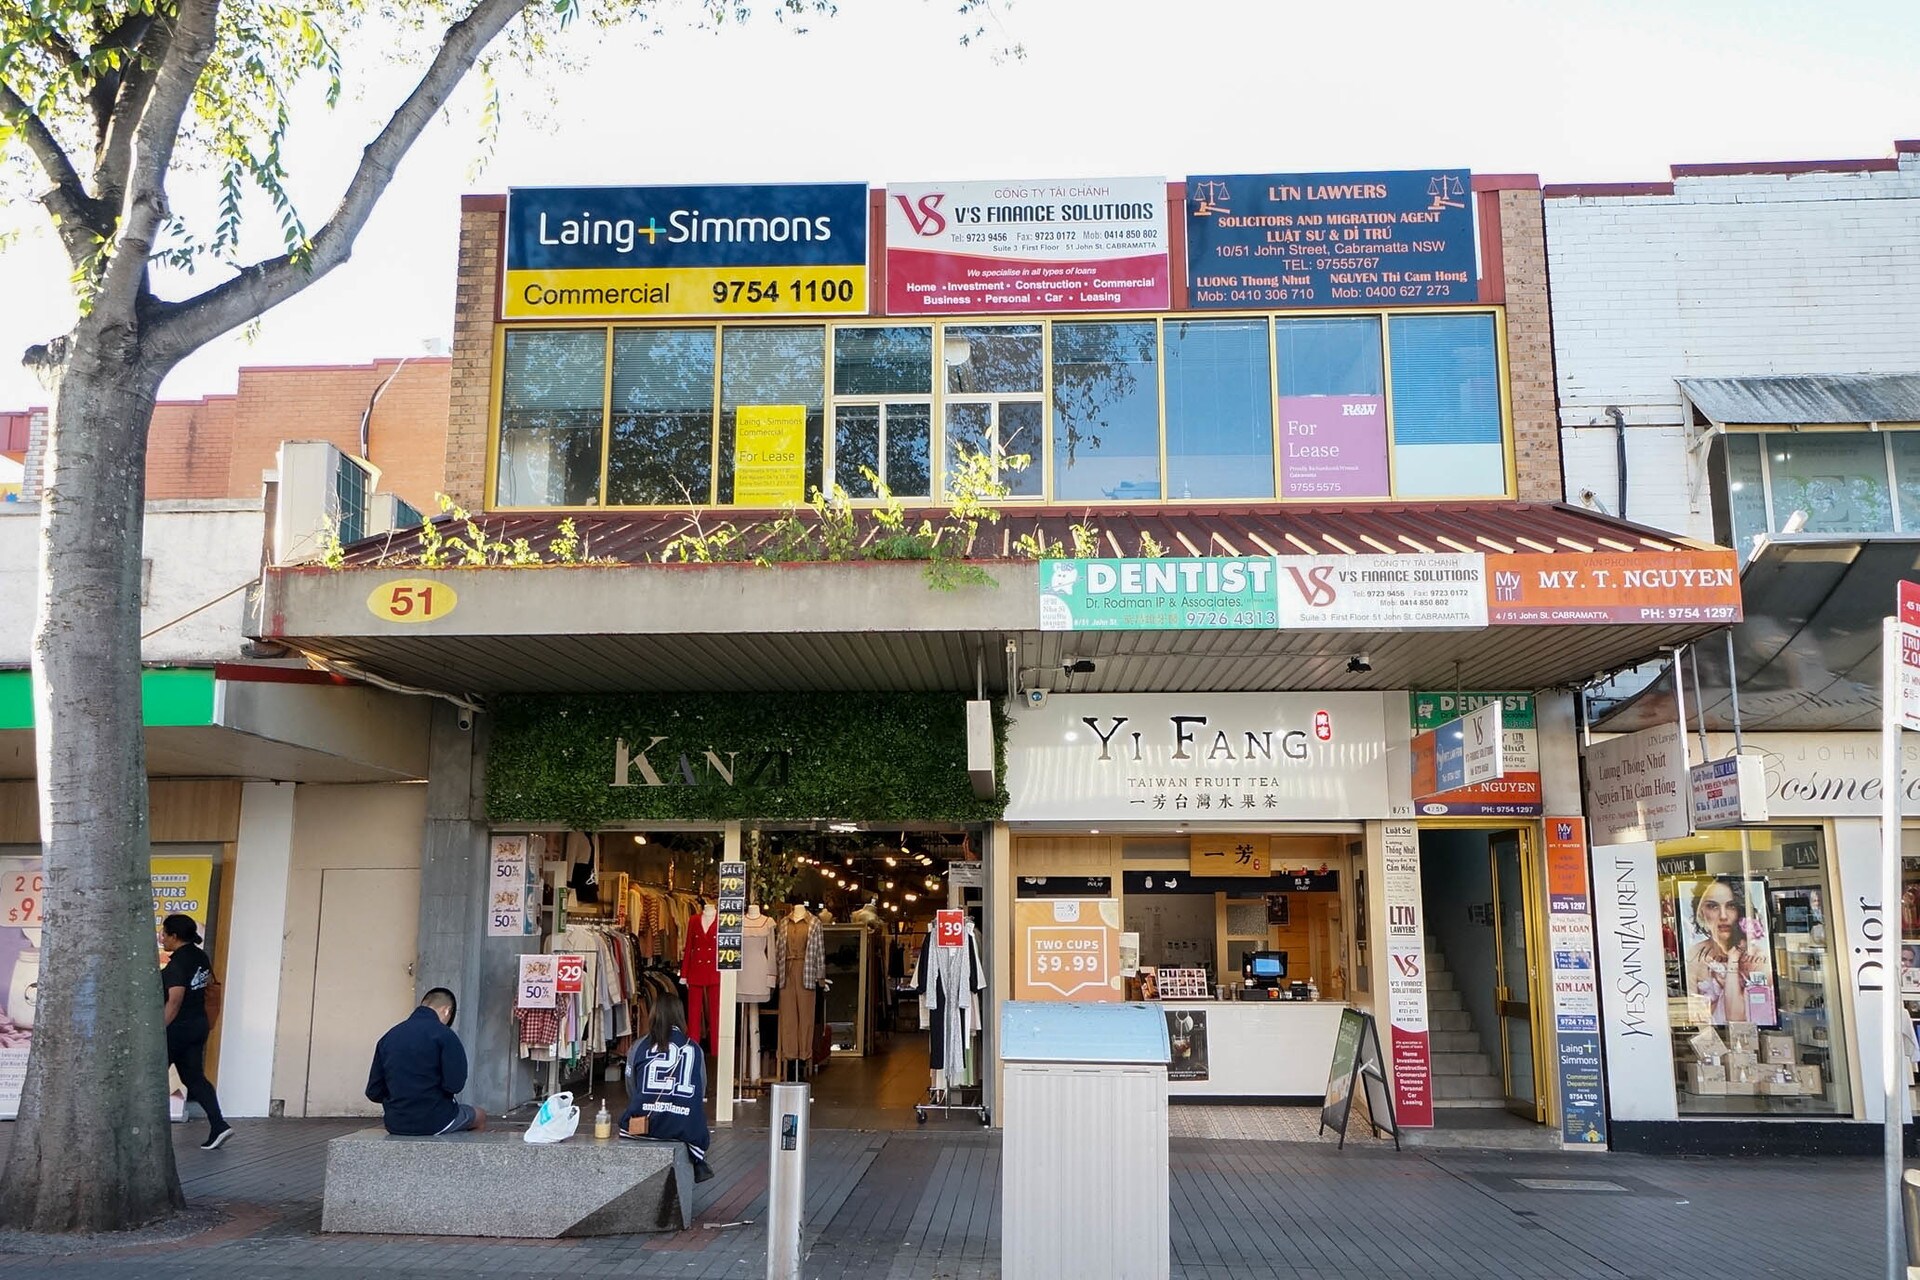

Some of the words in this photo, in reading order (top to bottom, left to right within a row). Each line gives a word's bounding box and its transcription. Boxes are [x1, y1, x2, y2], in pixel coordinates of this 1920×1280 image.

[1308, 185, 1386, 200] LAWYERS
[892, 194, 946, 237] VS
[955, 206, 981, 224] V'S
[987, 205, 1055, 223] FINANCE
[1062, 203, 1153, 221] SOLUTIONS
[1218, 216, 1293, 228] SOLICITORS
[1297, 214, 1322, 226] AND
[1327, 213, 1396, 225] MIGRATION
[1400, 212, 1440, 223] AGENT
[951, 234, 964, 242] Tel:
[966, 233, 985, 242] 9723
[988, 233, 1007, 241] 9456
[1017, 233, 1032, 241] Fax:
[1035, 232, 1054, 241] 9723
[1056, 231, 1075, 240] 0172
[1083, 231, 1101, 240] Mob:
[1104, 230, 1123, 239] 0414
[1126, 230, 1140, 239] 850
[1142, 230, 1157, 238] 802
[1106, 242, 1157, 250] CABRAMATTA
[1216, 246, 1250, 257] 10/51
[1254, 245, 1284, 256] John
[1289, 244, 1330, 256] Street,
[1335, 242, 1409, 254] Cabramatta
[1412, 242, 1445, 252] NSW
[1282, 260, 1312, 270] TEL:
[1316, 258, 1380, 270] 97555767
[967, 269, 980, 277] We
[982, 268, 1020, 277] specialise
[1022, 268, 1029, 276] in
[1042, 268, 1064, 277] types
[1065, 267, 1074, 275] of
[1075, 267, 1096, 275] loans
[1330, 273, 1377, 283] NGUYEN
[1382, 272, 1400, 282] Thi
[1404, 272, 1431, 282] Cam
[1436, 270, 1468, 283] Hong
[907, 283, 936, 292] Home
[948, 282, 1004, 291] Investment
[1015, 280, 1082, 290] Construction
[1093, 278, 1154, 288] Commercial
[1241, 276, 1278, 288] Thong
[1282, 274, 1310, 286] Nhut
[524, 282, 670, 305] Commercial
[712, 280, 779, 303] 9754
[789, 279, 853, 302] 1100
[1198, 290, 1227, 301] Mob:
[1231, 290, 1261, 300] 0410
[1265, 289, 1287, 300] 306
[1291, 288, 1314, 300] 710
[1332, 287, 1362, 298] Mob:
[1366, 286, 1396, 298] 0400
[1400, 286, 1422, 296] 627
[1427, 285, 1450, 296] 273
[924, 296, 970, 305] Business
[985, 294, 1030, 303] Personal
[1045, 294, 1063, 302] Car
[1080, 292, 1121, 304] Leasing
[1342, 404, 1377, 415] R&W
[1288, 421, 1317, 435] For
[740, 451, 758, 461] For
[762, 451, 795, 461] Lease
[1288, 442, 1340, 457] Lease
[1291, 483, 1314, 491] 9755
[1317, 483, 1341, 491] 5575
[1086, 561, 1272, 594] DENTIST
[1339, 570, 1357, 582] V'S
[1362, 570, 1408, 582] FINANCE
[1414, 569, 1478, 581] SOLUTIONS
[1496, 572, 1520, 590] My
[1538, 571, 1585, 589] MY.
[1592, 571, 1617, 588] T.
[1624, 569, 1733, 587] NGUYEN
[1283, 566, 1336, 607] VS
[390, 587, 432, 616] 51
[1086, 598, 1100, 608] Dr.
[1104, 597, 1152, 608] Rodman
[1156, 597, 1165, 607] IP
[1169, 597, 1177, 607] &
[1181, 597, 1243, 607] Associates.
[1187, 613, 1228, 625] 9726
[1234, 612, 1276, 624] 4313
[1641, 609, 1665, 618] PH:
[1669, 608, 1700, 618] 9754
[1704, 608, 1734, 617] 1297
[1798, 746, 1879, 760] JOHN
[1128, 778, 1187, 787] TAIWAN
[1195, 778, 1241, 787] FRUIT
[1249, 777, 1279, 787] TEA
[1481, 783, 1535, 792] NGUYEN
[1130, 794, 1278, 810] 一芳台灣水果茶
[1204, 845, 1254, 865] 一芳
[15, 876, 25, 893] 2
[165, 902, 198, 911] SAGO
[720, 902, 741, 910] SALE
[1553, 902, 1568, 910] 9754
[1570, 902, 1585, 910] 1297
[1390, 906, 1415, 925] LTN
[1390, 926, 1416, 934] LAWYERS
[719, 938, 740, 946] SALE
[1036, 940, 1063, 949] TWO
[1067, 940, 1099, 949] CUPS
[1855, 897, 1883, 997] Dior
[1037, 954, 1098, 973] $9.99
[1392, 954, 1420, 977] VS
[558, 966, 581, 982] $29
[1556, 983, 1571, 991] KIM
[1575, 983, 1593, 991] LAM
[1561, 1056, 1598, 1065] Simmons
[642, 1042, 695, 1098] 21
